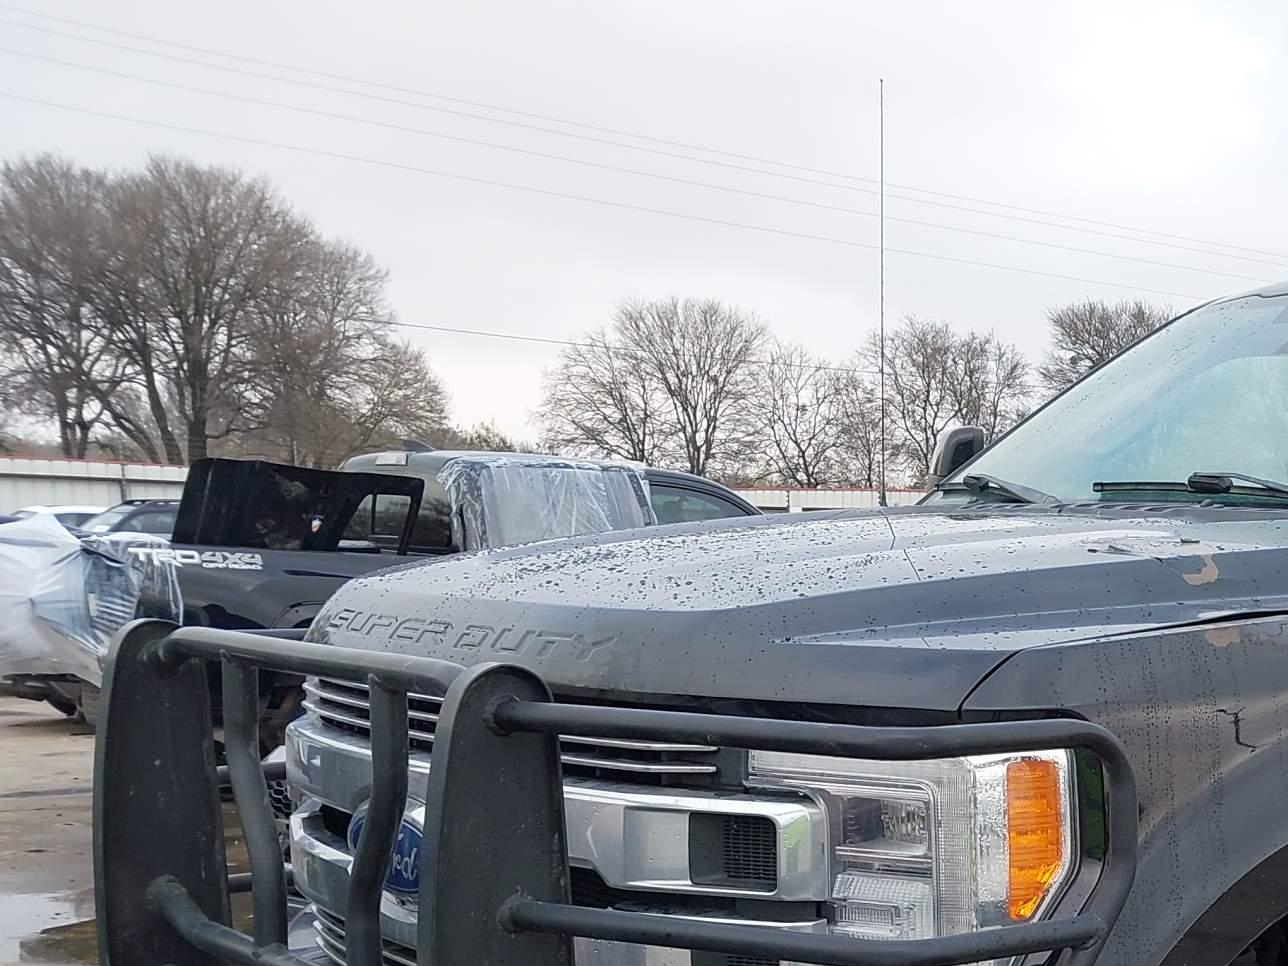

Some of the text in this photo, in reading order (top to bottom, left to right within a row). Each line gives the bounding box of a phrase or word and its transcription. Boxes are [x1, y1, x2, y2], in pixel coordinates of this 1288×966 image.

[127, 547, 201, 567] TRD
[328, 607, 618, 663] SUPER DUTY
